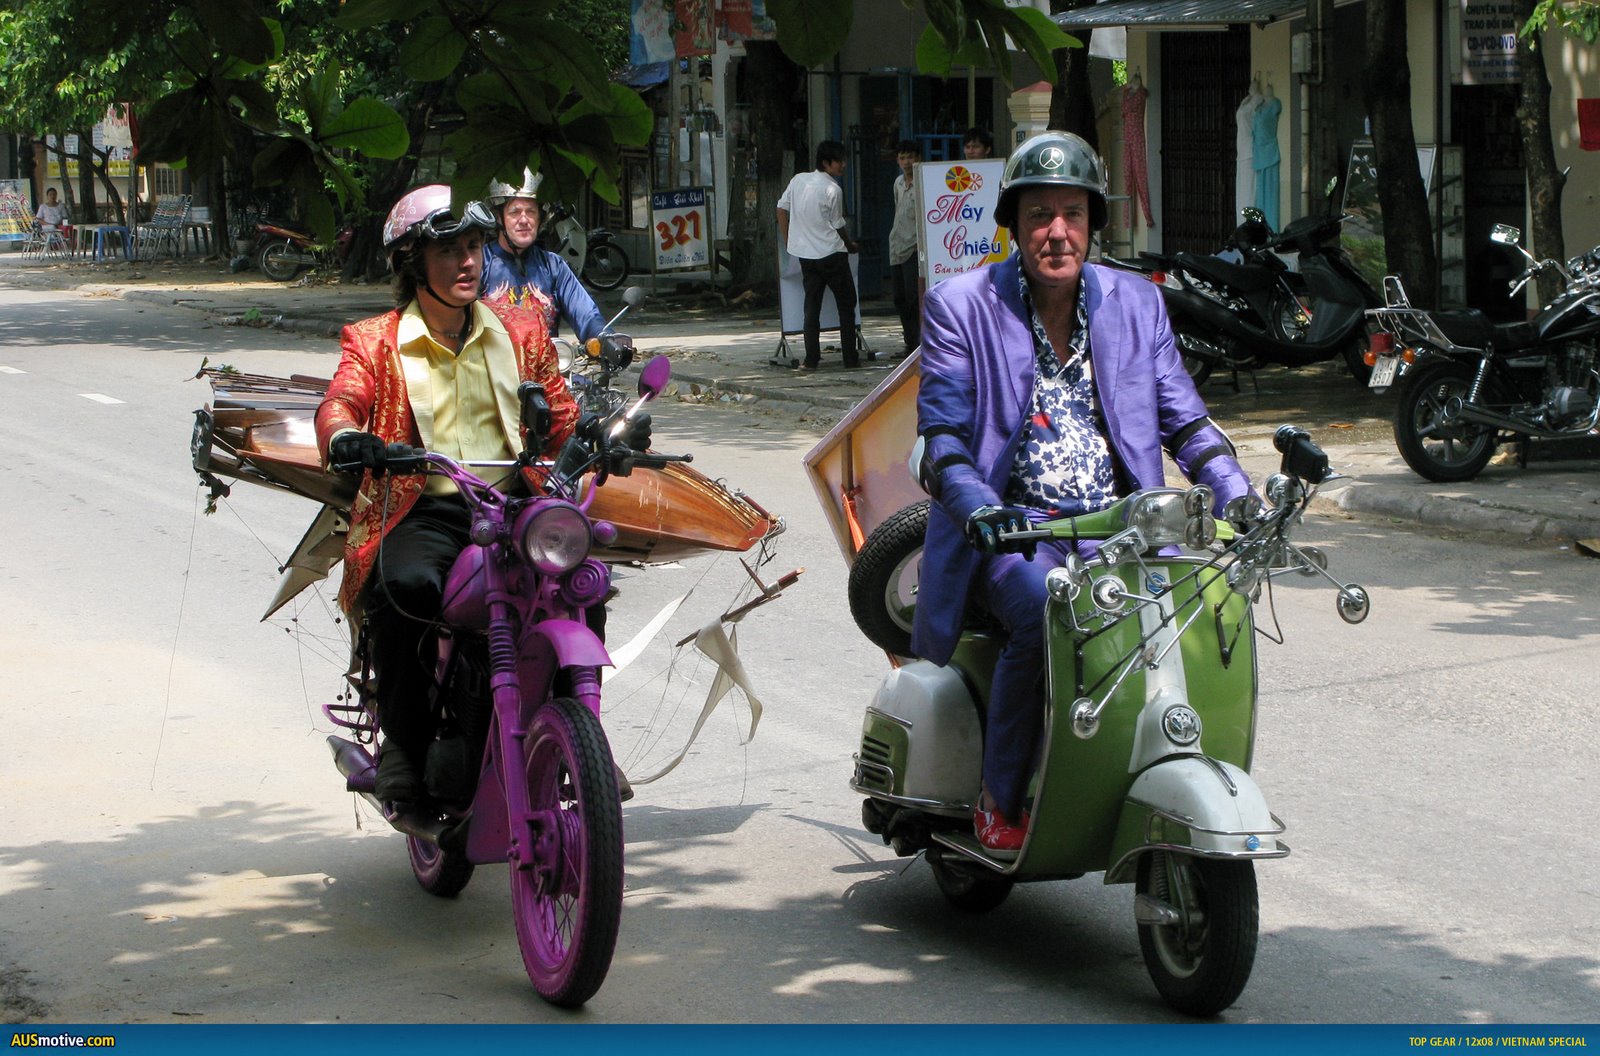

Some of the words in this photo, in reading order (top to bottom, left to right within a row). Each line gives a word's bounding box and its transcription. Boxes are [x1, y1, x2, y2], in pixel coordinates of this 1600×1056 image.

[1464, 20, 1485, 30] TRAO
[1467, 35, 1515, 51] CD-VCD-DVD
[927, 193, 984, 224] Mây
[656, 210, 702, 252] 327
[943, 225, 1001, 259] Chiều
[934, 263, 951, 274] Bán
